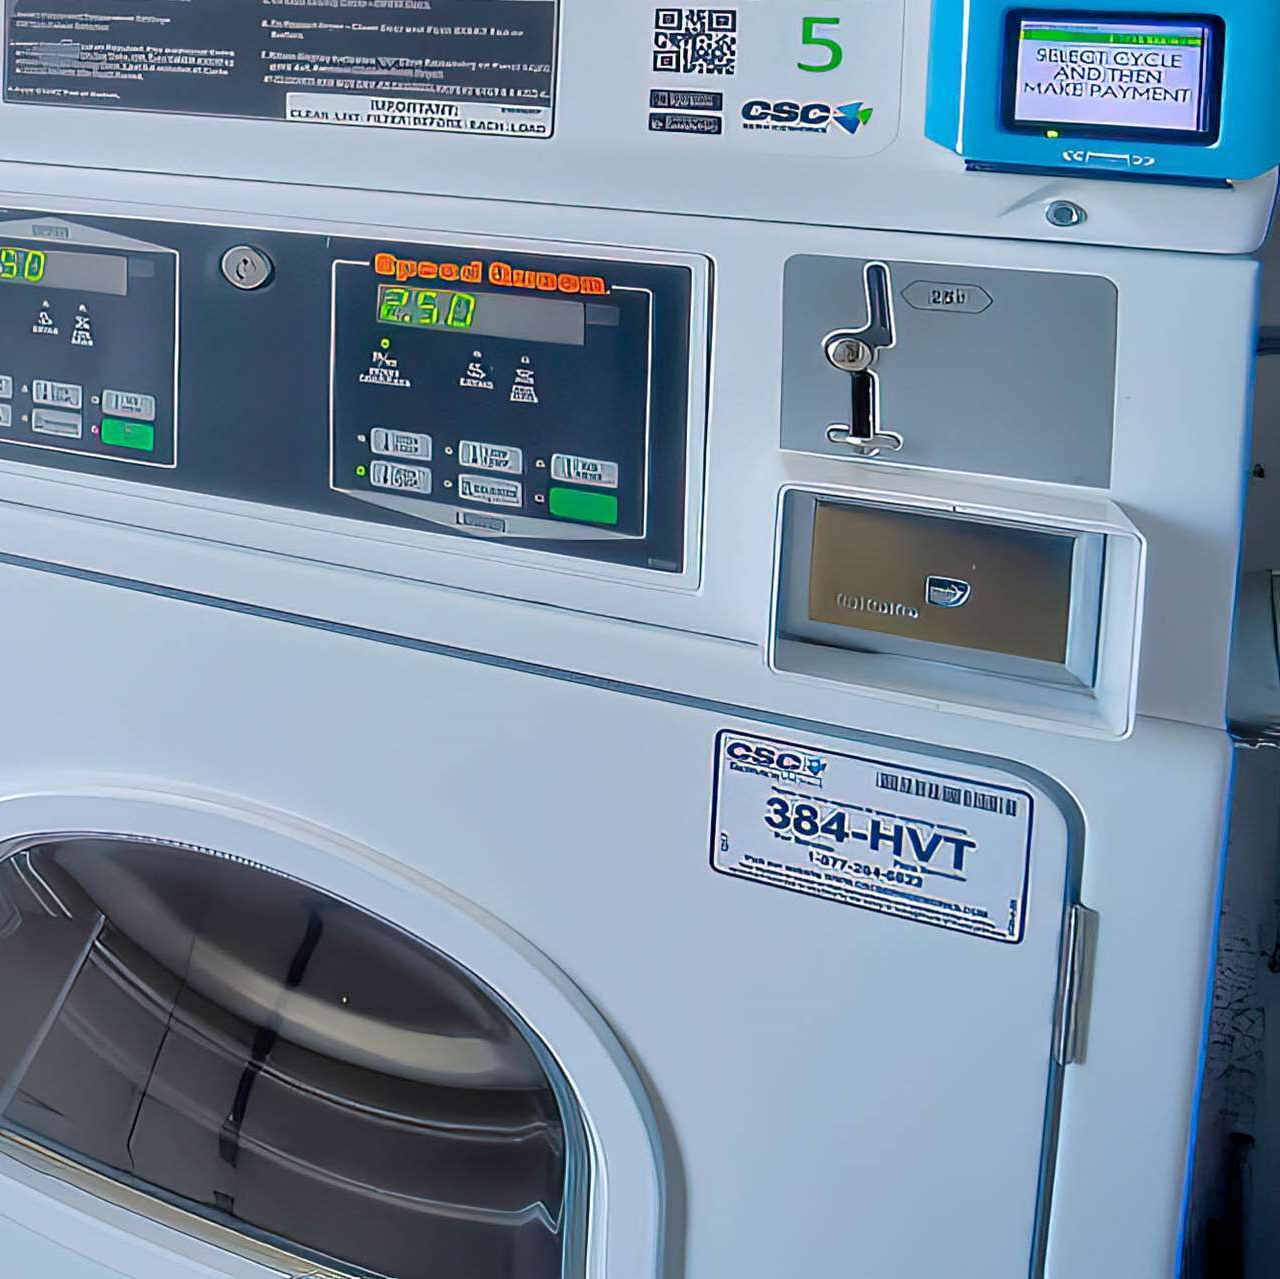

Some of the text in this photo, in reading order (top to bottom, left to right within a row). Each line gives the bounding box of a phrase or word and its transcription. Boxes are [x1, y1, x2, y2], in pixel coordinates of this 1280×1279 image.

[797, 16, 844, 73] 5
[1036, 47, 1183, 69] SELECT CYCLE
[1053, 66, 1162, 85] AND THEN
[1024, 82, 1191, 104] MAKE PAYMENT
[740, 99, 832, 125] CSC
[374, 252, 612, 296] Speed Queen
[379, 287, 479, 330] 2.50
[725, 741, 802, 772] CSC
[763, 795, 978, 873] 384-HVT
